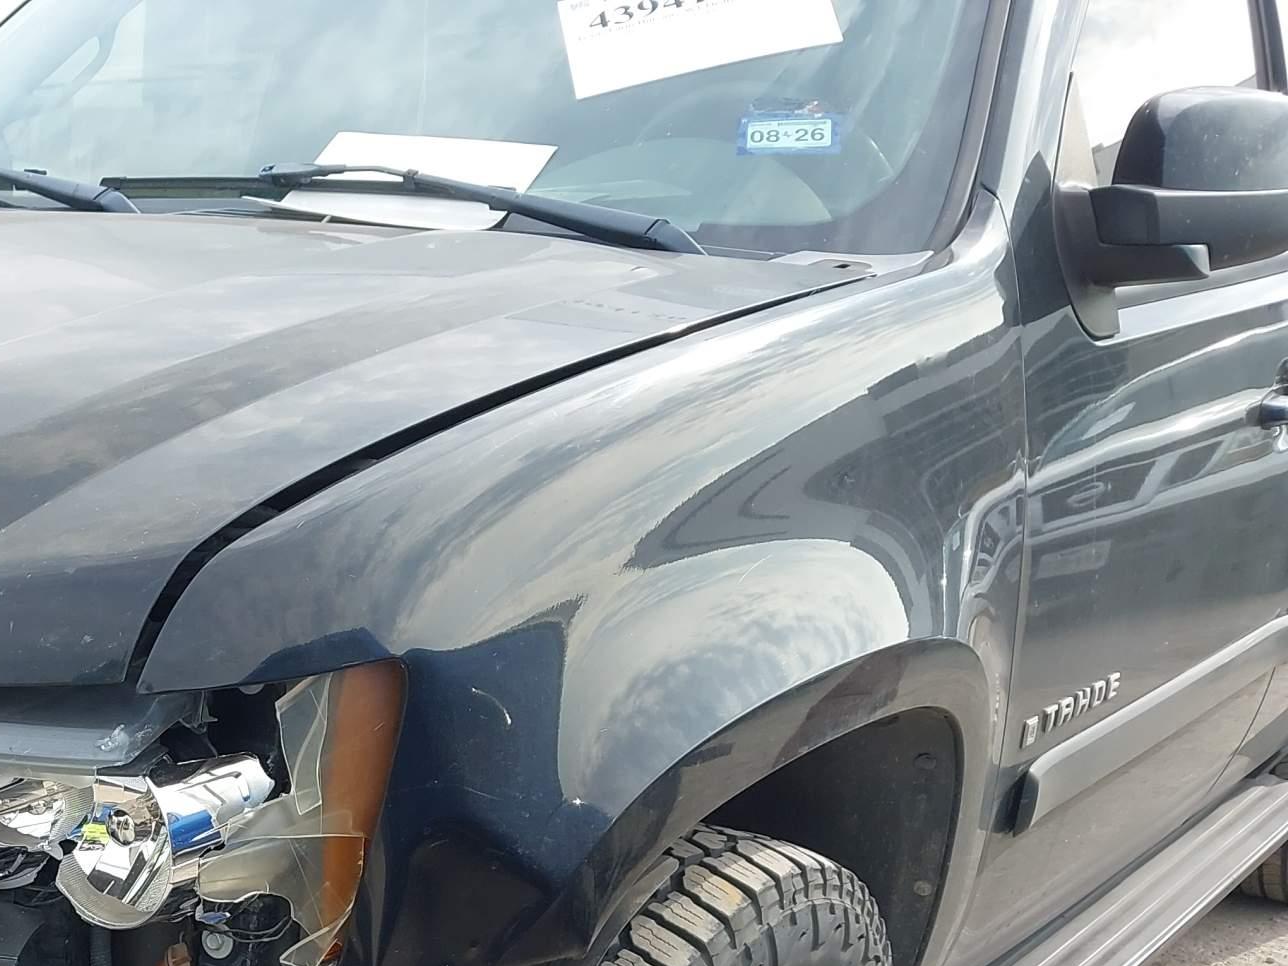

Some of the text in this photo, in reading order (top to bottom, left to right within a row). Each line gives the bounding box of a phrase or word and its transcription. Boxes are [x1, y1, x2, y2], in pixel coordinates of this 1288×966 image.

[750, 127, 825, 143] 08 26
[1042, 671, 1121, 733] TAHOE
